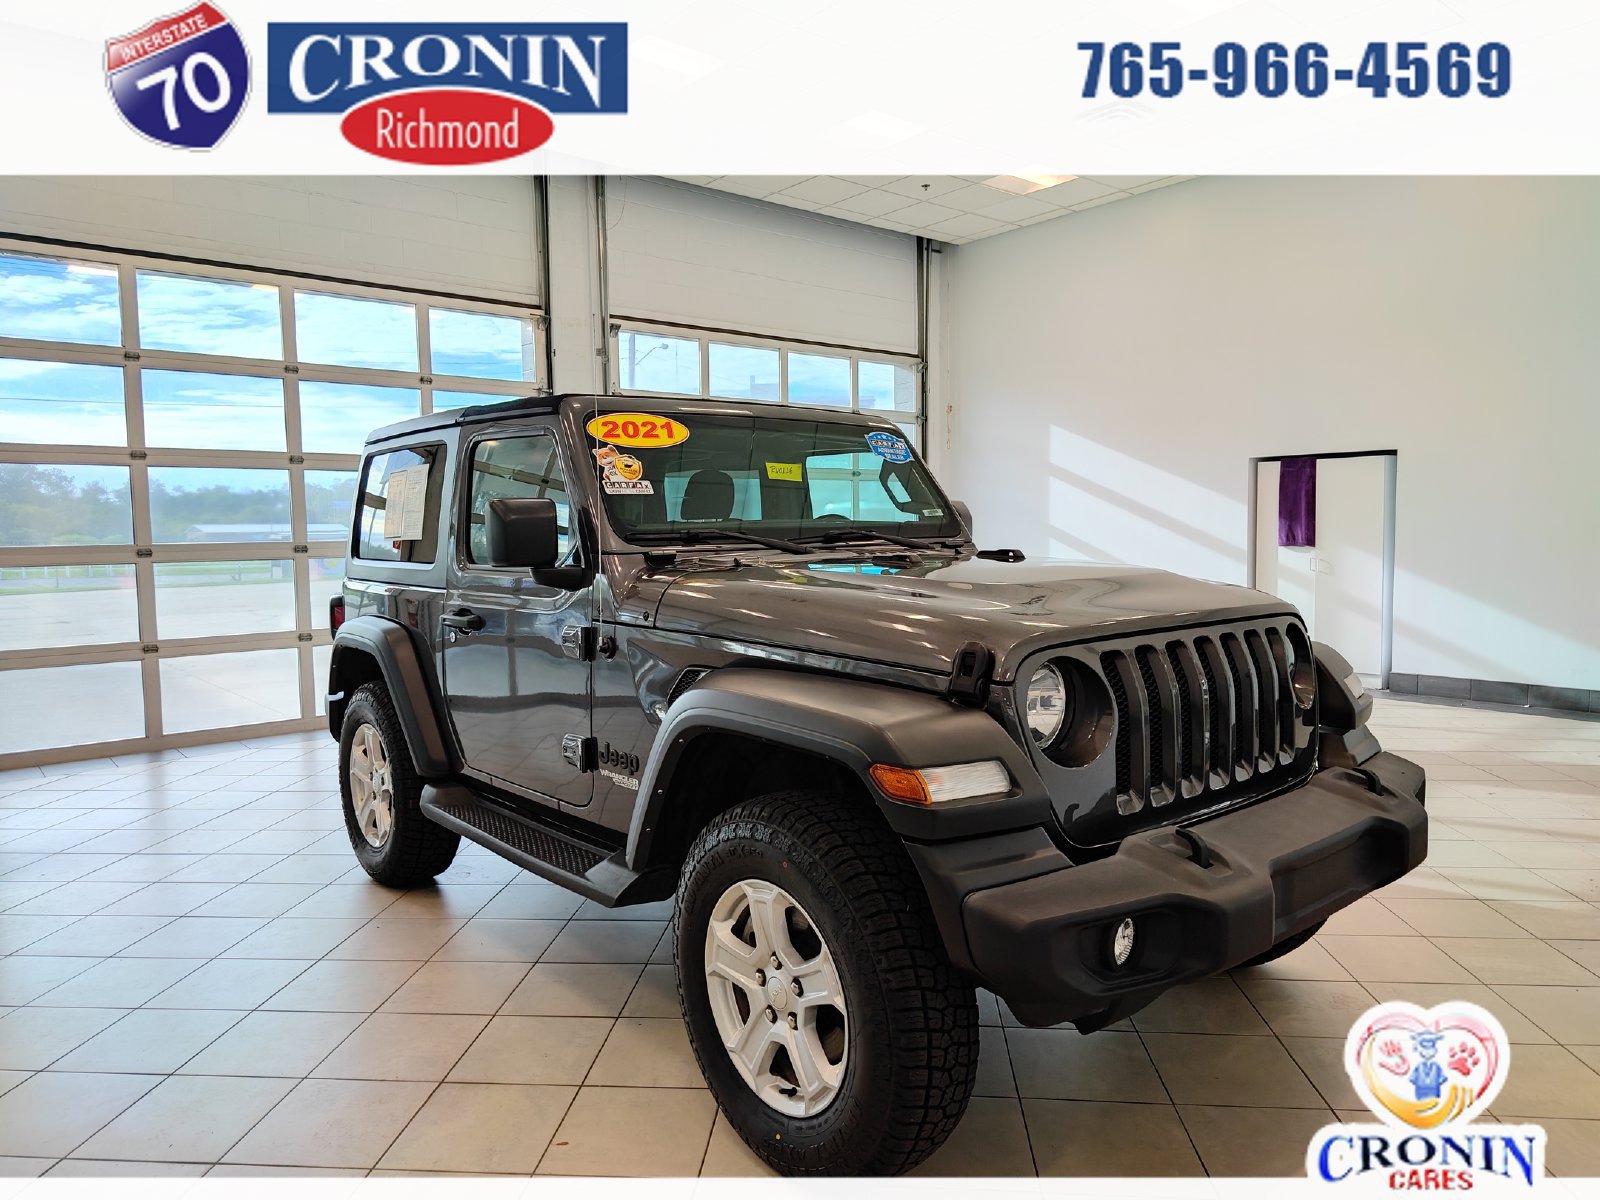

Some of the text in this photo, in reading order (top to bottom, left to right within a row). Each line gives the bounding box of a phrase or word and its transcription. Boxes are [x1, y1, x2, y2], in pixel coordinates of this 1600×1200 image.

[601, 420, 675, 439] 2021
[605, 481, 649, 489] CARFAX
[599, 742, 639, 775] Jeep
[599, 768, 639, 787] WRANGLER
